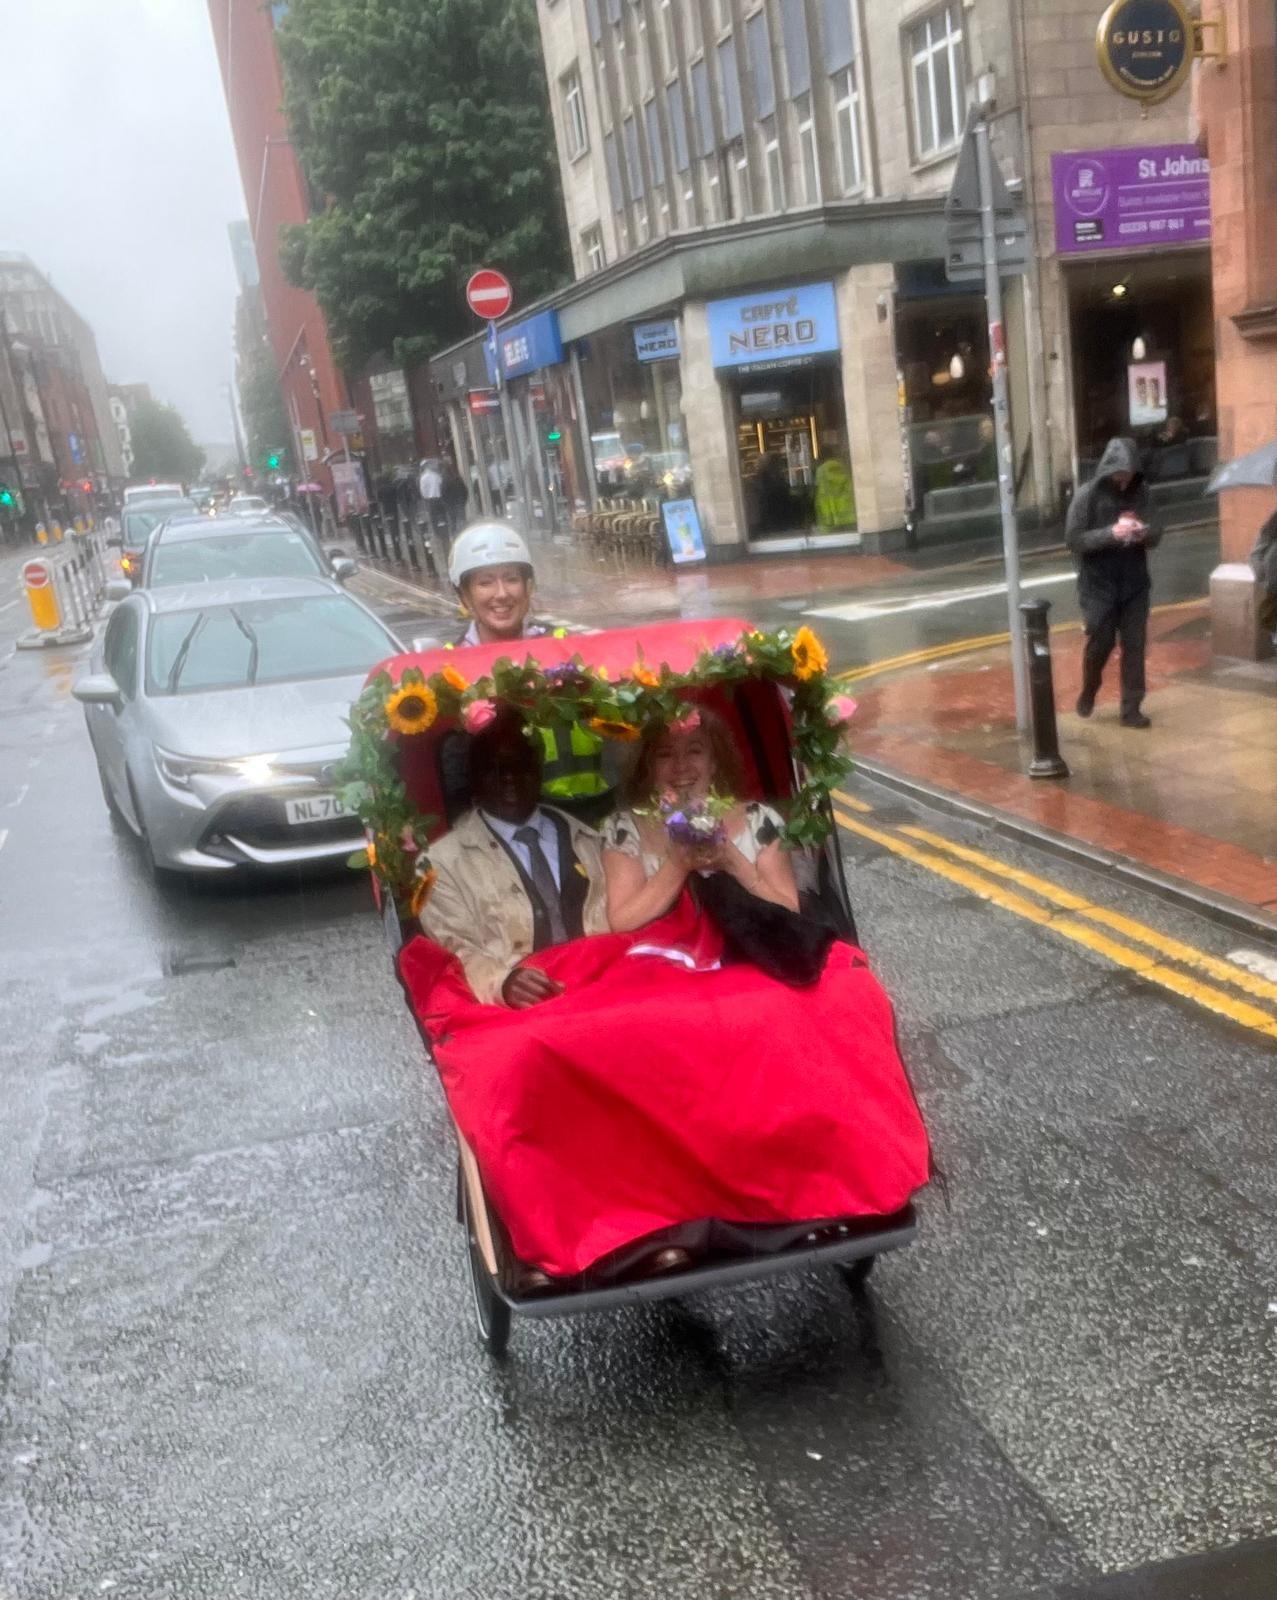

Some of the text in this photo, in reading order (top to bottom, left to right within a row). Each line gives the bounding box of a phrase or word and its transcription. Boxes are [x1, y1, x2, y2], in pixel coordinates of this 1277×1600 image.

[1138, 155, 1210, 179] St Johns
[638, 339, 678, 354] NERO
[730, 319, 816, 356] NERO
